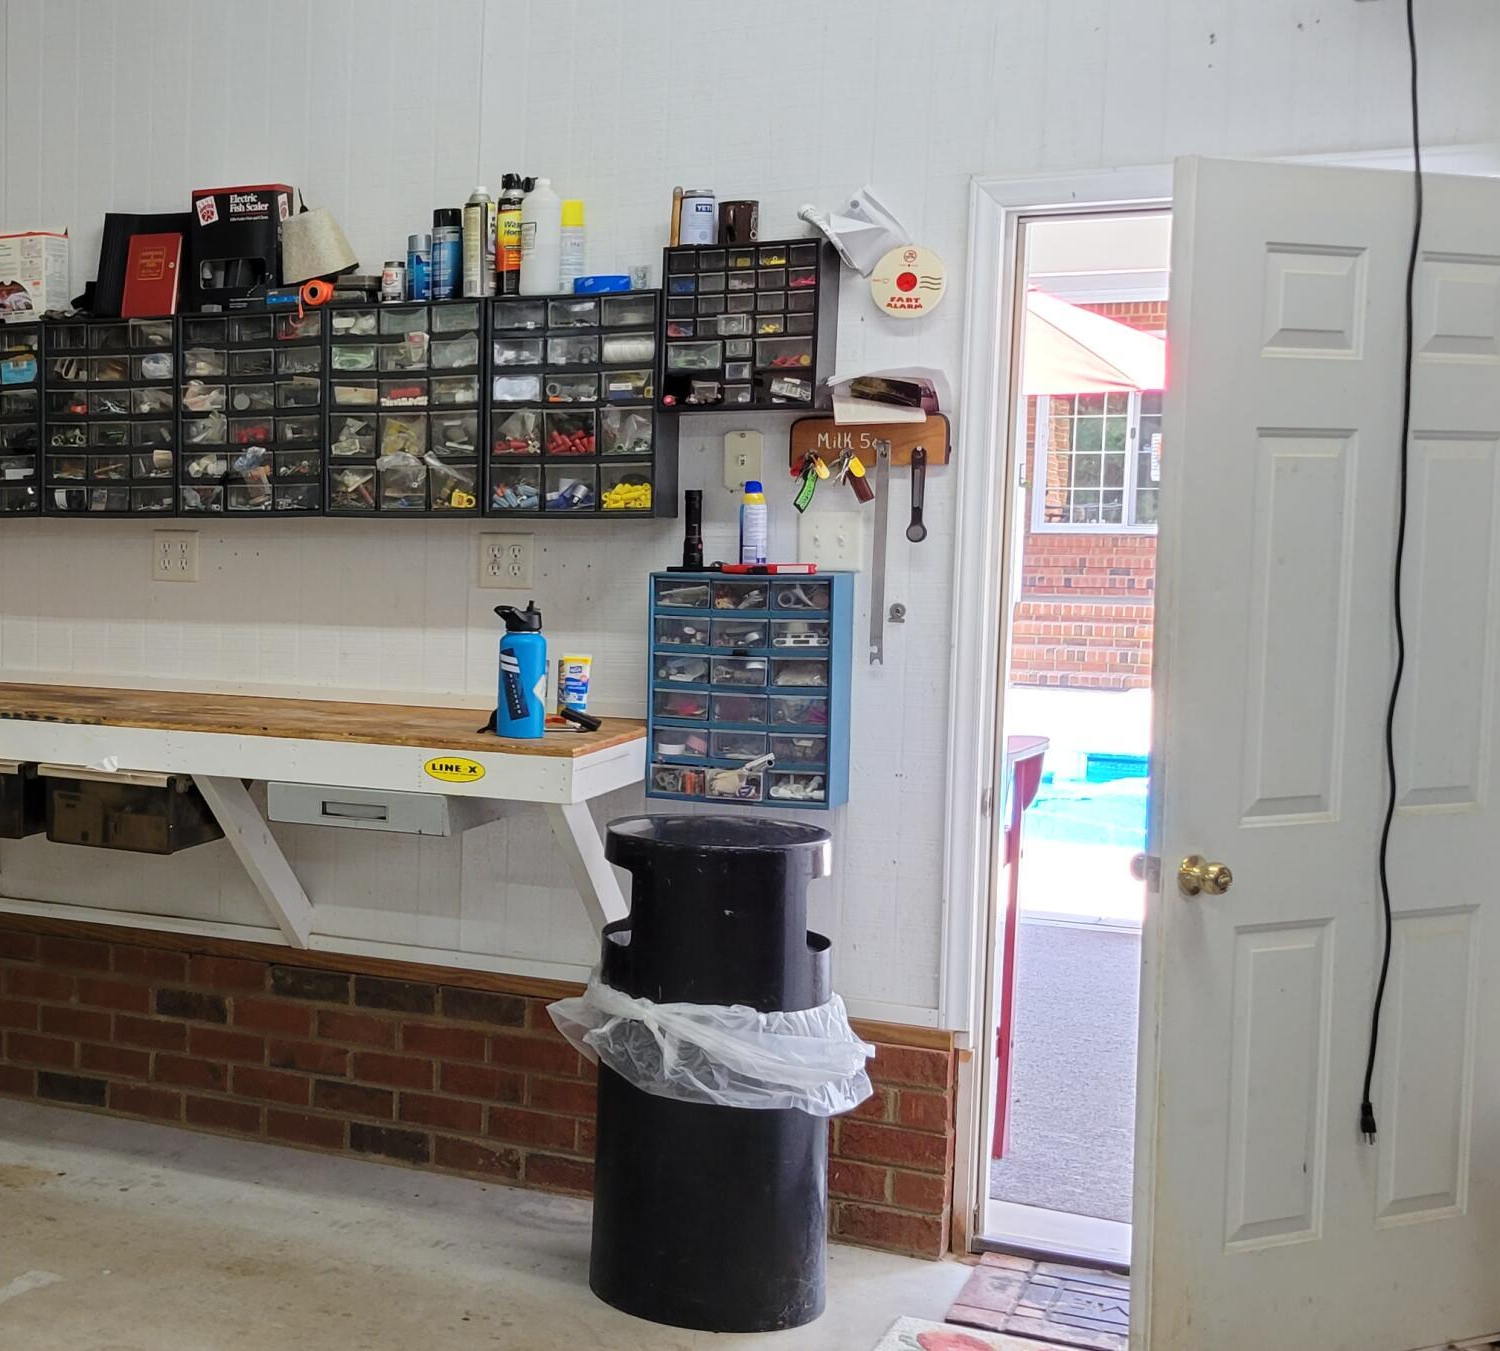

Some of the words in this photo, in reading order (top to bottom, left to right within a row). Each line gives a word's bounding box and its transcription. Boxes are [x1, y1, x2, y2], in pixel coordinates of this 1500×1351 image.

[229, 192, 258, 204] Electric
[229, 203, 245, 213] Fish
[245, 202, 269, 212] Scaler
[696, 204, 713, 212] YETI
[886, 302, 923, 310] ALARM
